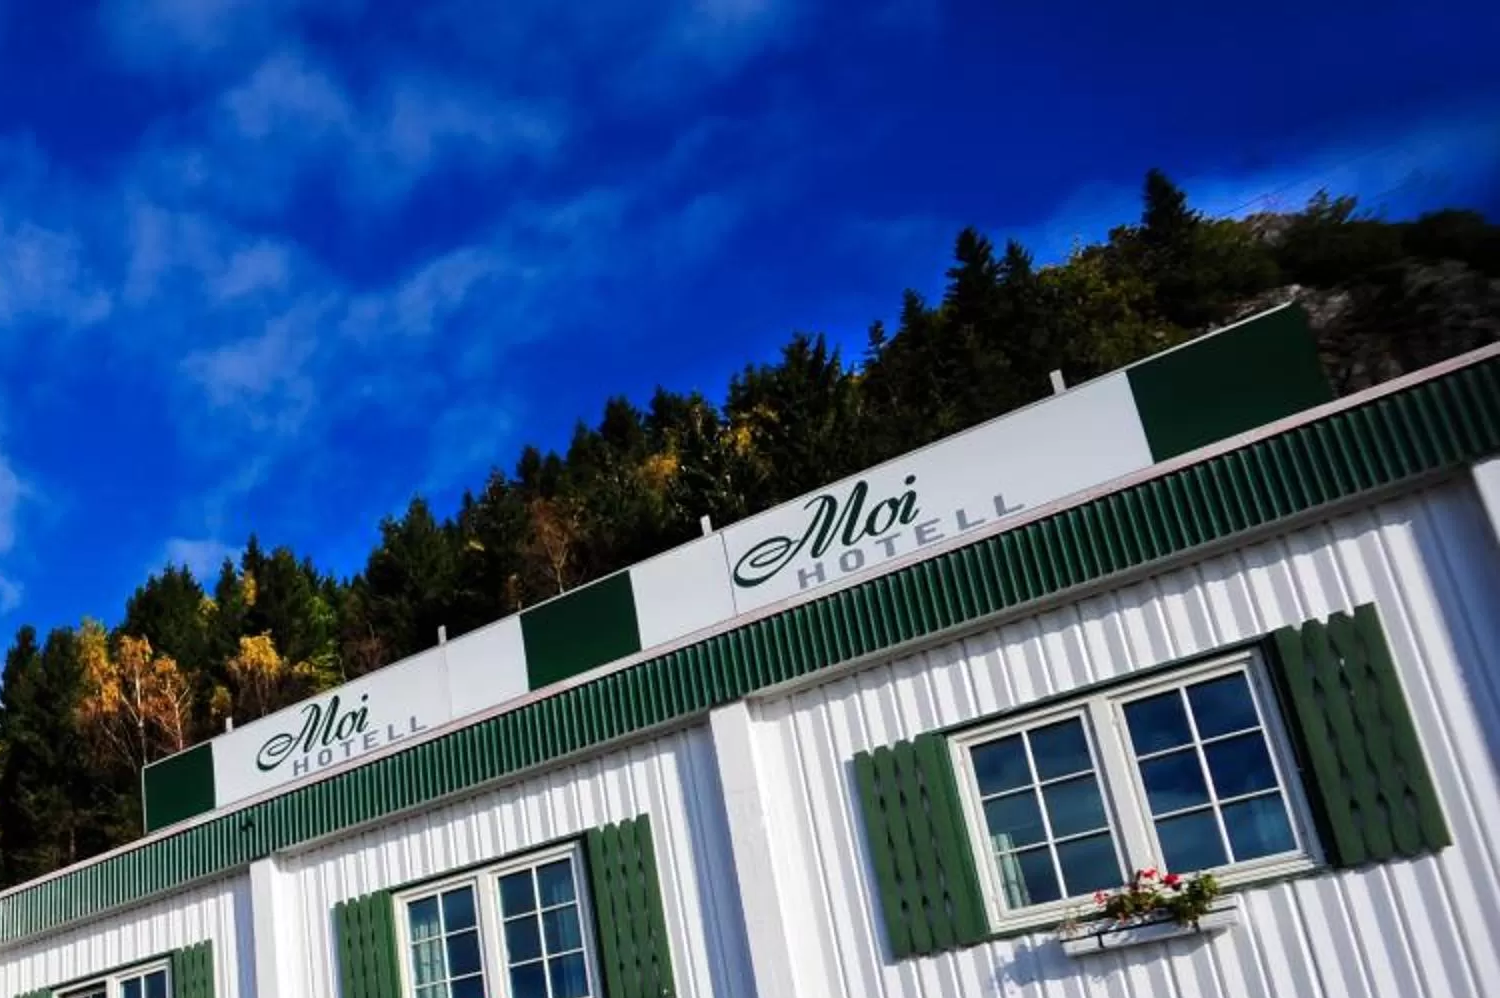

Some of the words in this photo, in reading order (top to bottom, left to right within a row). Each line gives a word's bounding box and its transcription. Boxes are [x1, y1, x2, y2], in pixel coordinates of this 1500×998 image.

[733, 474, 921, 589] Moi
[797, 493, 1026, 589] HOTELL
[256, 693, 371, 772] Moi
[293, 715, 427, 777] HOTELL
